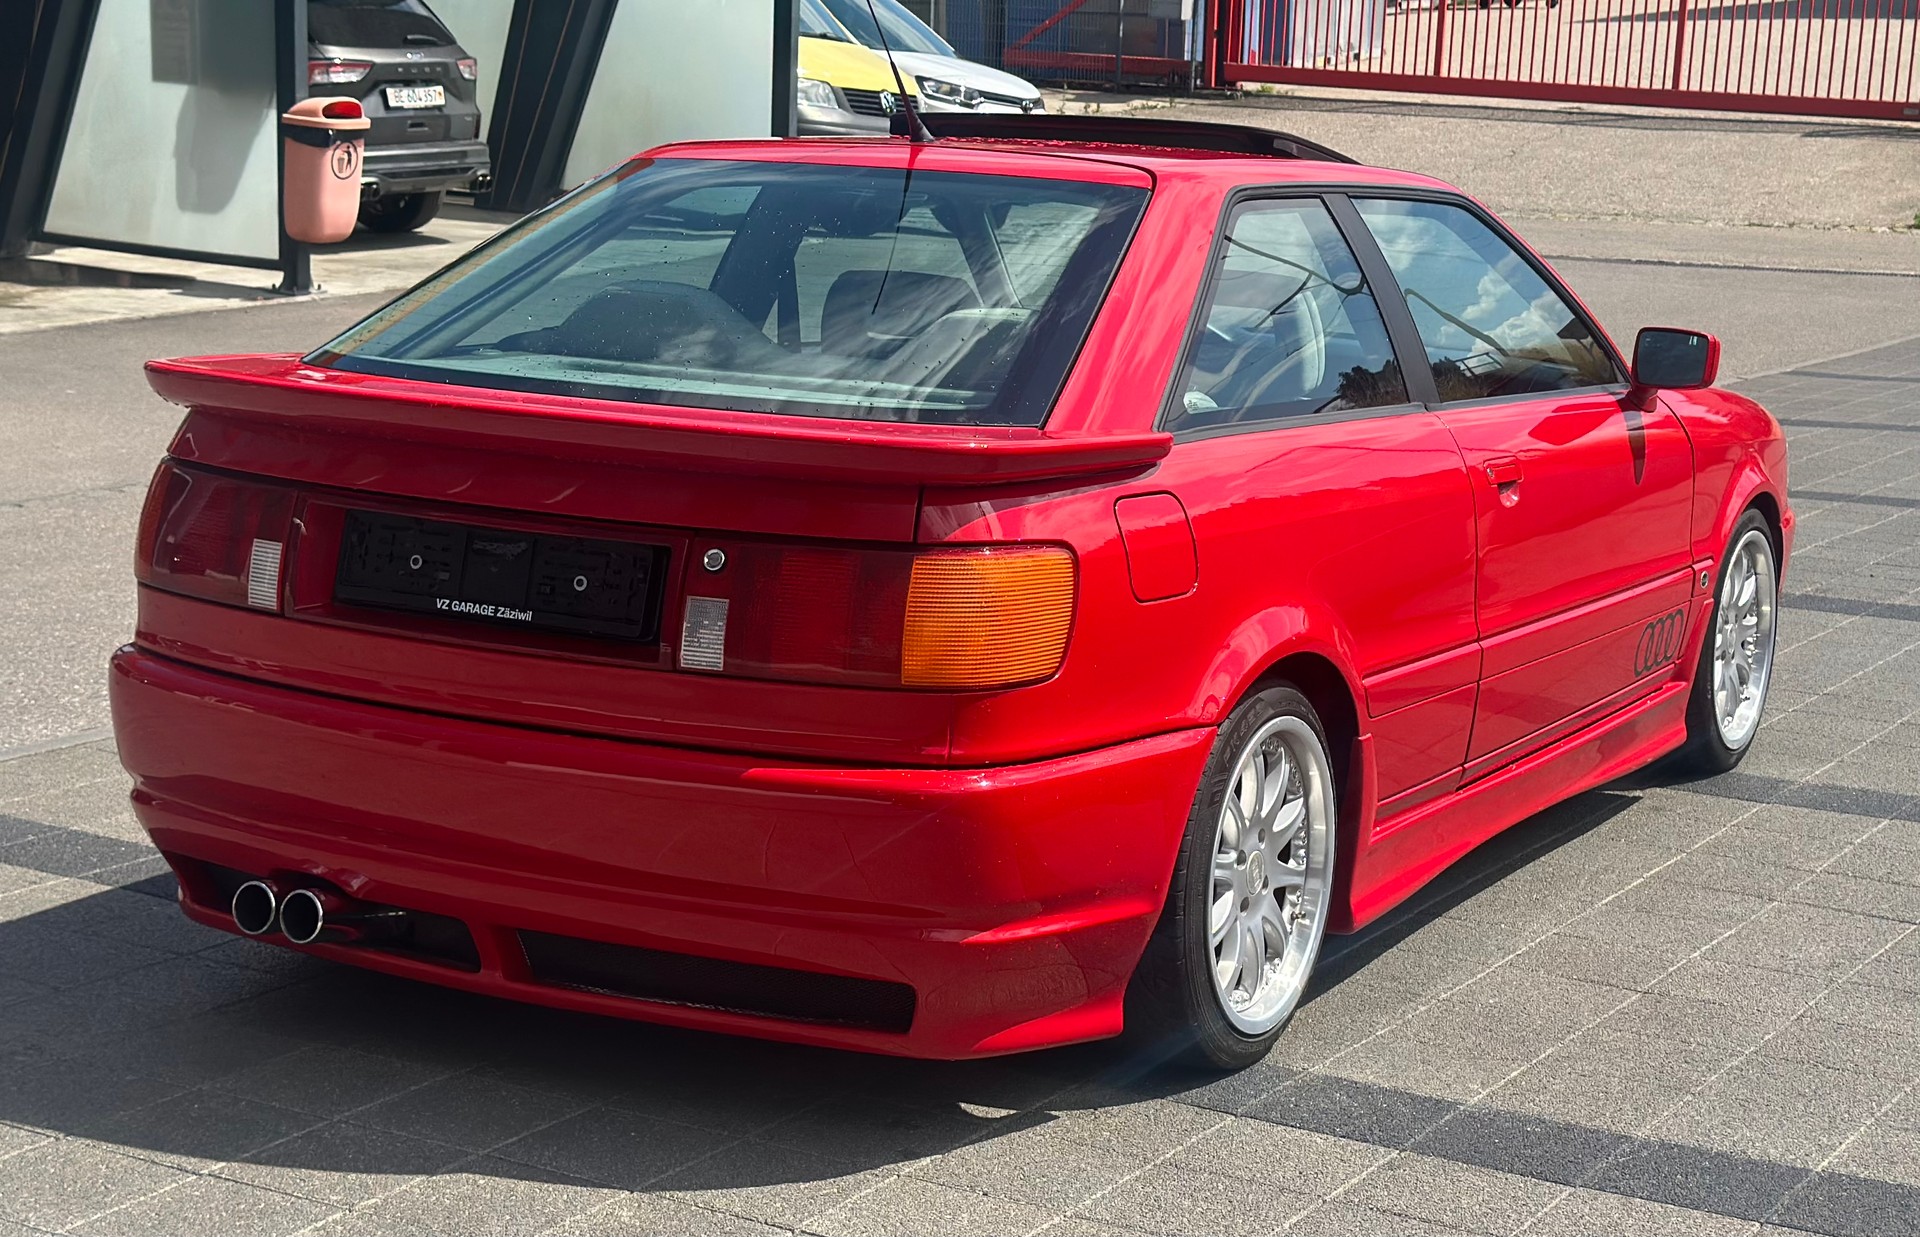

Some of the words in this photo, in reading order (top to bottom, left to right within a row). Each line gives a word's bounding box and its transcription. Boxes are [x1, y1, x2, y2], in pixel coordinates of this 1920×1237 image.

[393, 89, 405, 103] BE
[436, 598, 450, 610] VZ
[451, 600, 496, 616] GARAGE
[497, 606, 532, 621] Zäziwil
